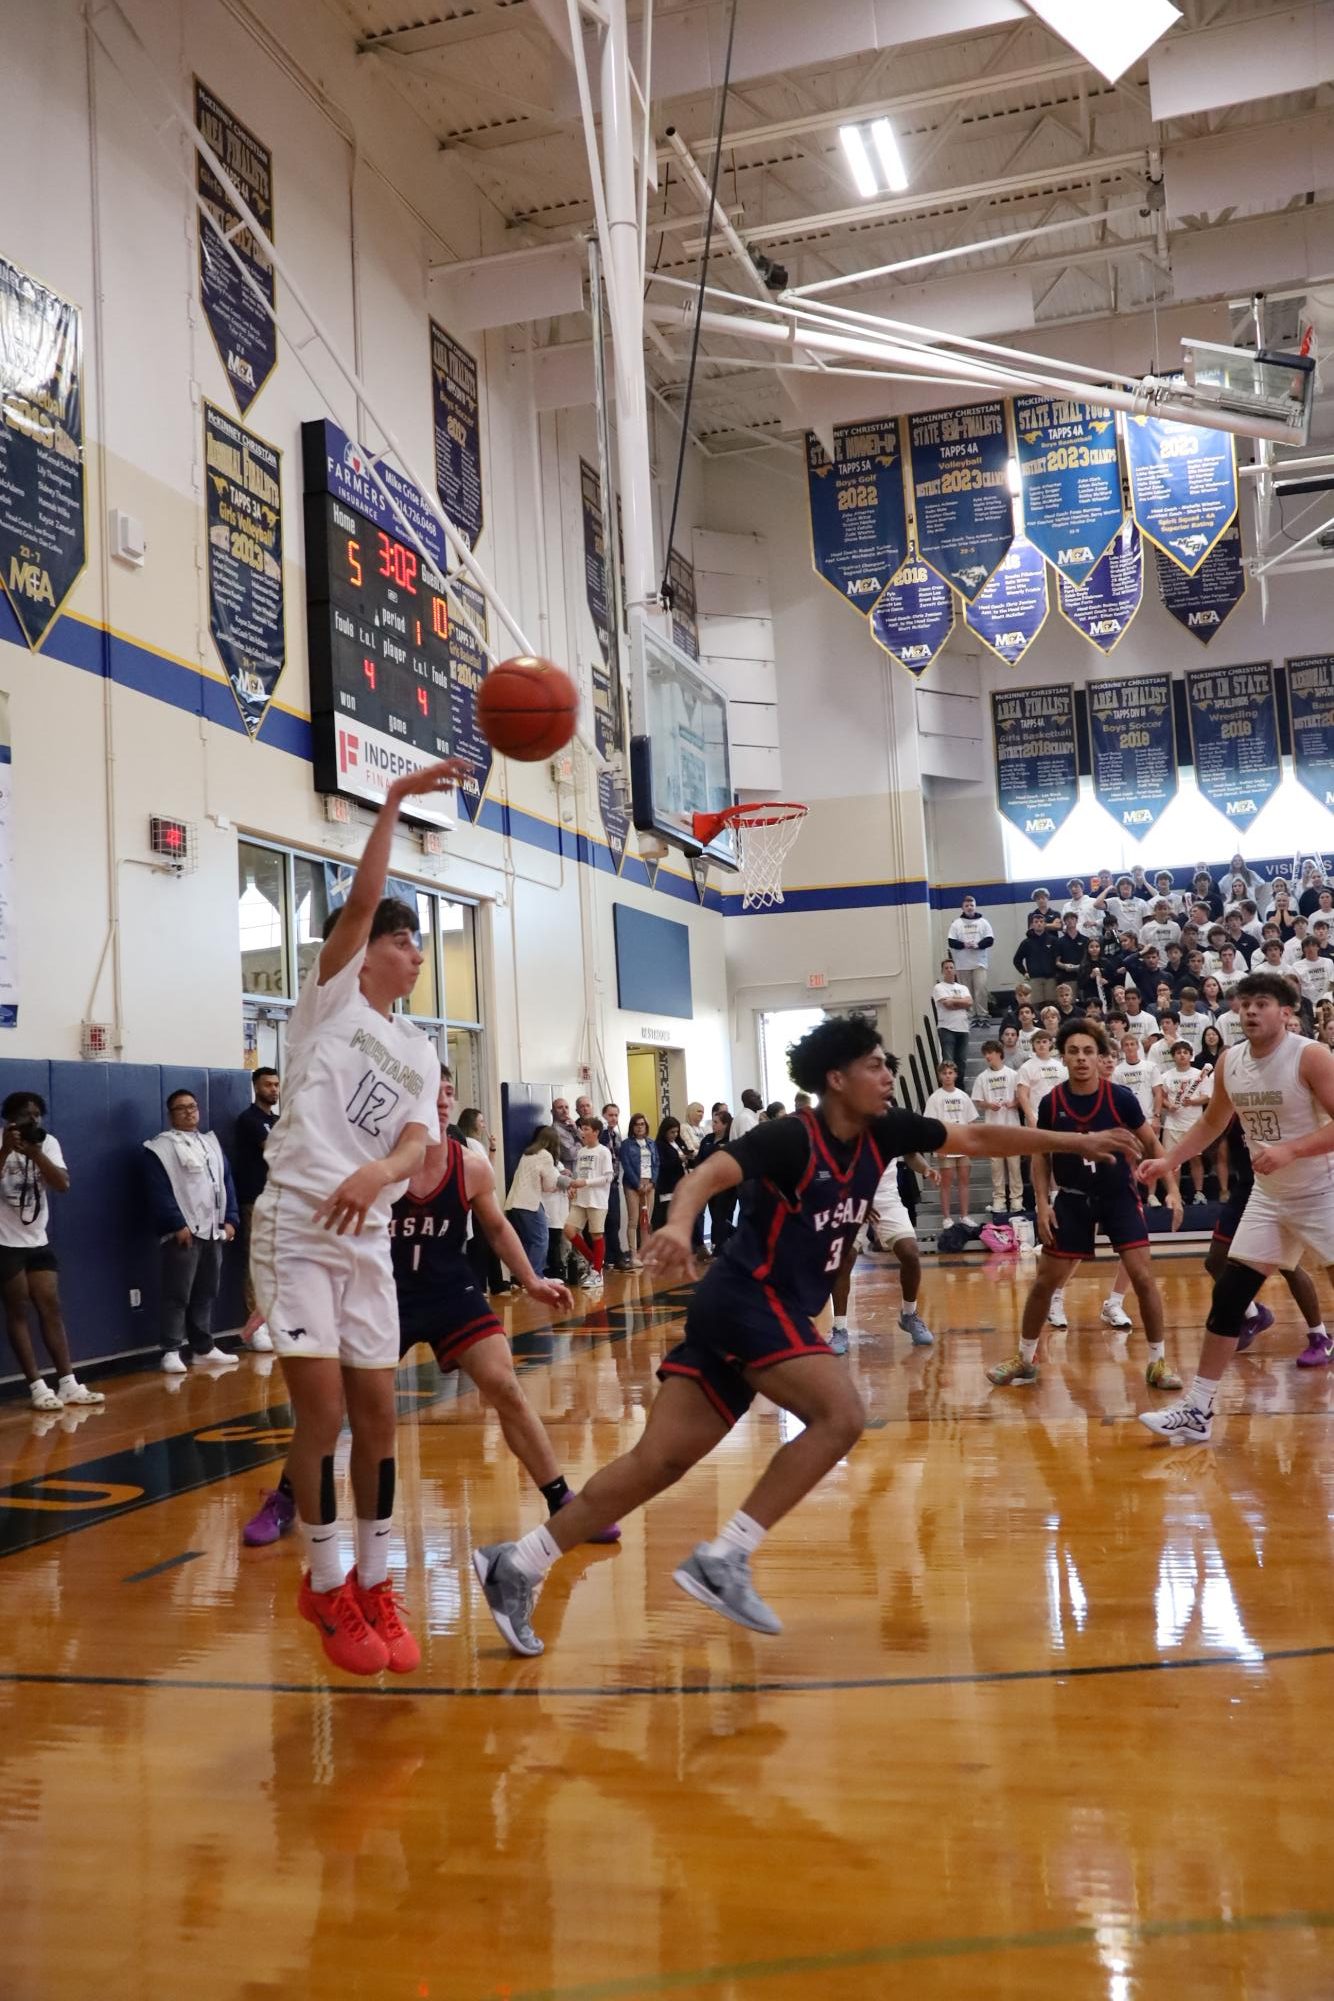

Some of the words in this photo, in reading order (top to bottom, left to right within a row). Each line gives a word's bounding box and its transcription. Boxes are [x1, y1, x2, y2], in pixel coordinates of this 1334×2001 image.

[912, 411, 953, 425] McKINNEY
[955, 404, 1001, 417] CHRISTIAN
[1019, 404, 1051, 430] STATE
[1052, 400, 1083, 426] FINAL
[208, 410, 241, 442] McKINNEY
[242, 434, 277, 465] CHRISTIAN
[850, 422, 895, 435] CHRISTIAN
[913, 421, 940, 447] STATE
[1048, 426, 1072, 441] TAPPS
[1073, 424, 1084, 436] 4A
[941, 444, 966, 458] TAPPS
[967, 442, 979, 454] 4A
[1047, 446, 1090, 472] 2023
[1089, 448, 1117, 465] CHAMPS
[1160, 436, 1199, 459] 2023
[838, 462, 861, 476] TAPPS
[861, 459, 872, 472] 5A
[938, 456, 982, 470] Volleyball
[327, 457, 386, 511] FARMERS
[385, 470, 402, 493] Mike
[836, 478, 857, 488] Boys
[858, 474, 877, 483] Golf
[941, 468, 983, 494] 2023
[230, 486, 251, 513] TAPPS
[338, 486, 378, 521] INSURANCE
[838, 485, 879, 511] 2022
[333, 502, 356, 535] Home
[1158, 517, 1177, 526] Spirit
[1179, 514, 1200, 523] Squad
[1161, 524, 1190, 533] Superior
[1192, 520, 1214, 530] Rating
[347, 540, 362, 588] 5
[378, 531, 417, 596] 3:02
[1057, 546, 1095, 565] MCA
[846, 577, 882, 595] MCA
[382, 607, 406, 634] period
[432, 596, 448, 640] 10
[1089, 619, 1121, 636] MCA
[1188, 610, 1220, 626] MCA
[415, 619, 422, 646] 1
[995, 632, 1027, 647] MCA
[334, 610, 354, 638] fouls
[383, 638, 407, 665] player
[431, 665, 448, 689] fouls
[901, 644, 932, 659] MCA
[1128, 677, 1166, 687] CHRISTIAN
[1190, 670, 1227, 681] McKINNEY
[1228, 665, 1267, 676] CHRISTIAN
[363, 658, 376, 690] 4
[416, 686, 429, 717] 4
[995, 691, 1029, 701] McKINNEY
[1031, 687, 1069, 698] CHRISTIAN
[1093, 690, 1119, 711] AREA
[1122, 686, 1168, 708] FINALIST
[1192, 679, 1214, 700] 4TH
[1217, 677, 1230, 697] IN
[1233, 674, 1270, 695] STATE
[997, 701, 1023, 721] AREA
[1025, 697, 1070, 718] FINALIST
[1113, 709, 1130, 720] TAPPS
[1209, 709, 1258, 722] Wrestling
[340, 691, 357, 711] won
[388, 714, 407, 735] game
[436, 737, 450, 755] won
[1020, 719, 1036, 729] TAPPS
[1103, 724, 1127, 733] Boys
[1129, 719, 1163, 730] Soccer
[1000, 733, 1021, 743] Girls
[1023, 727, 1072, 741] Basketball
[1119, 731, 1151, 749] 2018
[1123, 809, 1154, 825] MCA
[1308, 967, 1325, 975] WHITE
[345, 1069, 400, 1138] 12
[1242, 1110, 1281, 1141] 33
[413, 1244, 421, 1271] 1
[824, 1236, 844, 1272] 3
